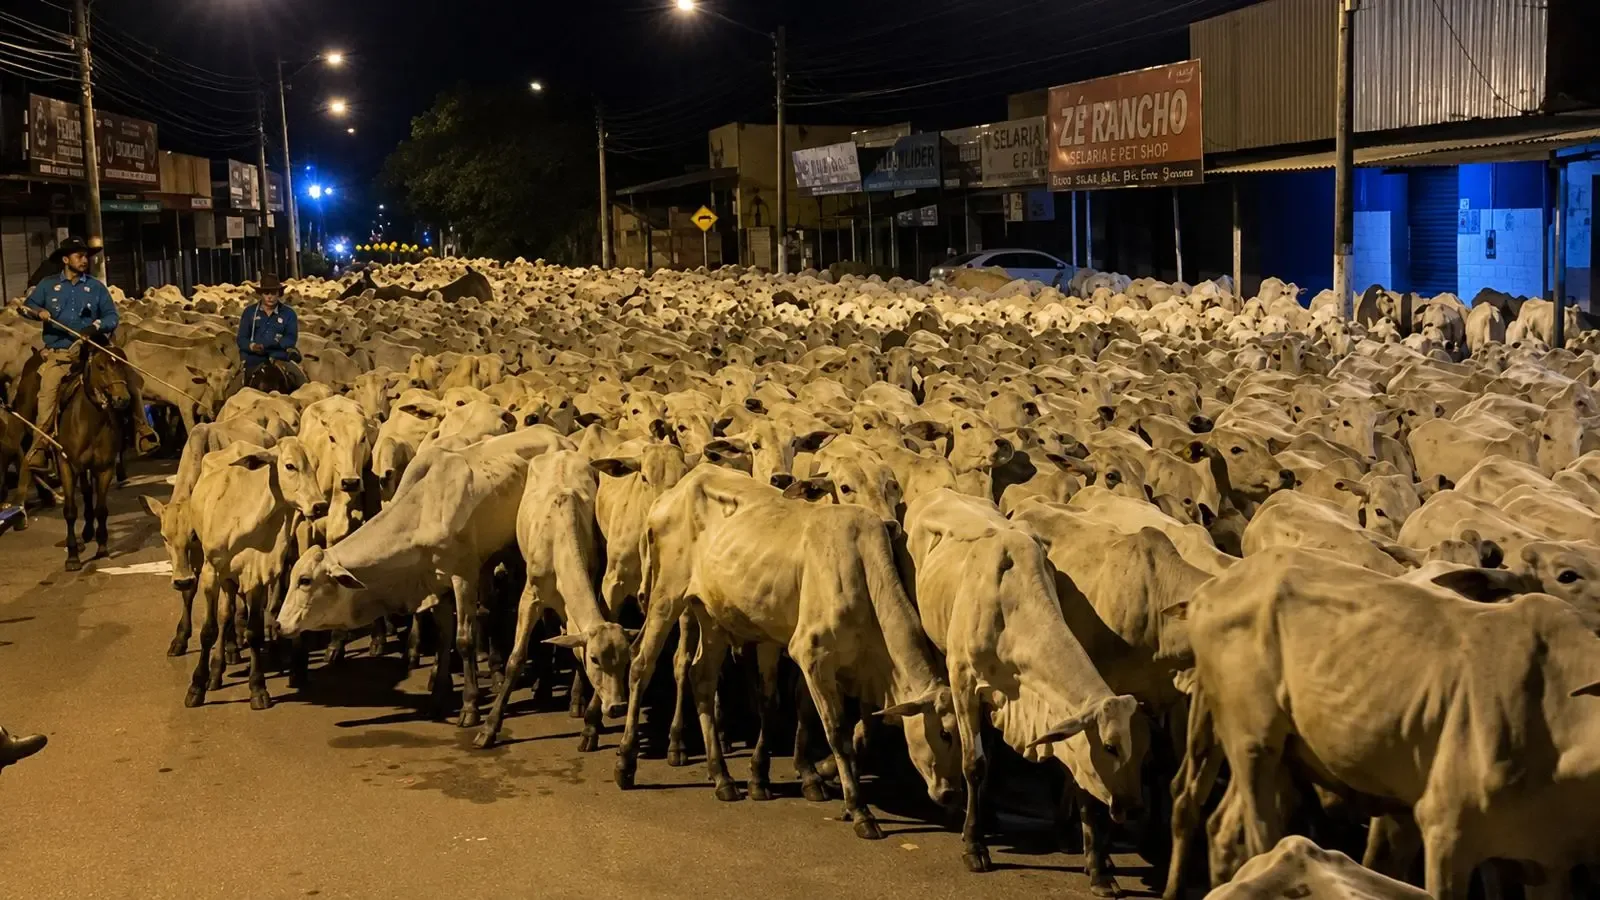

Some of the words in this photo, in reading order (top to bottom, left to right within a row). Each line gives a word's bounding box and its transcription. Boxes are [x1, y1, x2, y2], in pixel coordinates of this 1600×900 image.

[1059, 95, 1088, 147] ZÉ
[1091, 88, 1188, 144] RANCHO
[993, 125, 1042, 150] SELARIA
[1070, 150, 1108, 165] SELARIA
[1110, 149, 1117, 162] E
[1119, 145, 1138, 160] PET
[1140, 142, 1169, 159] SHOP
